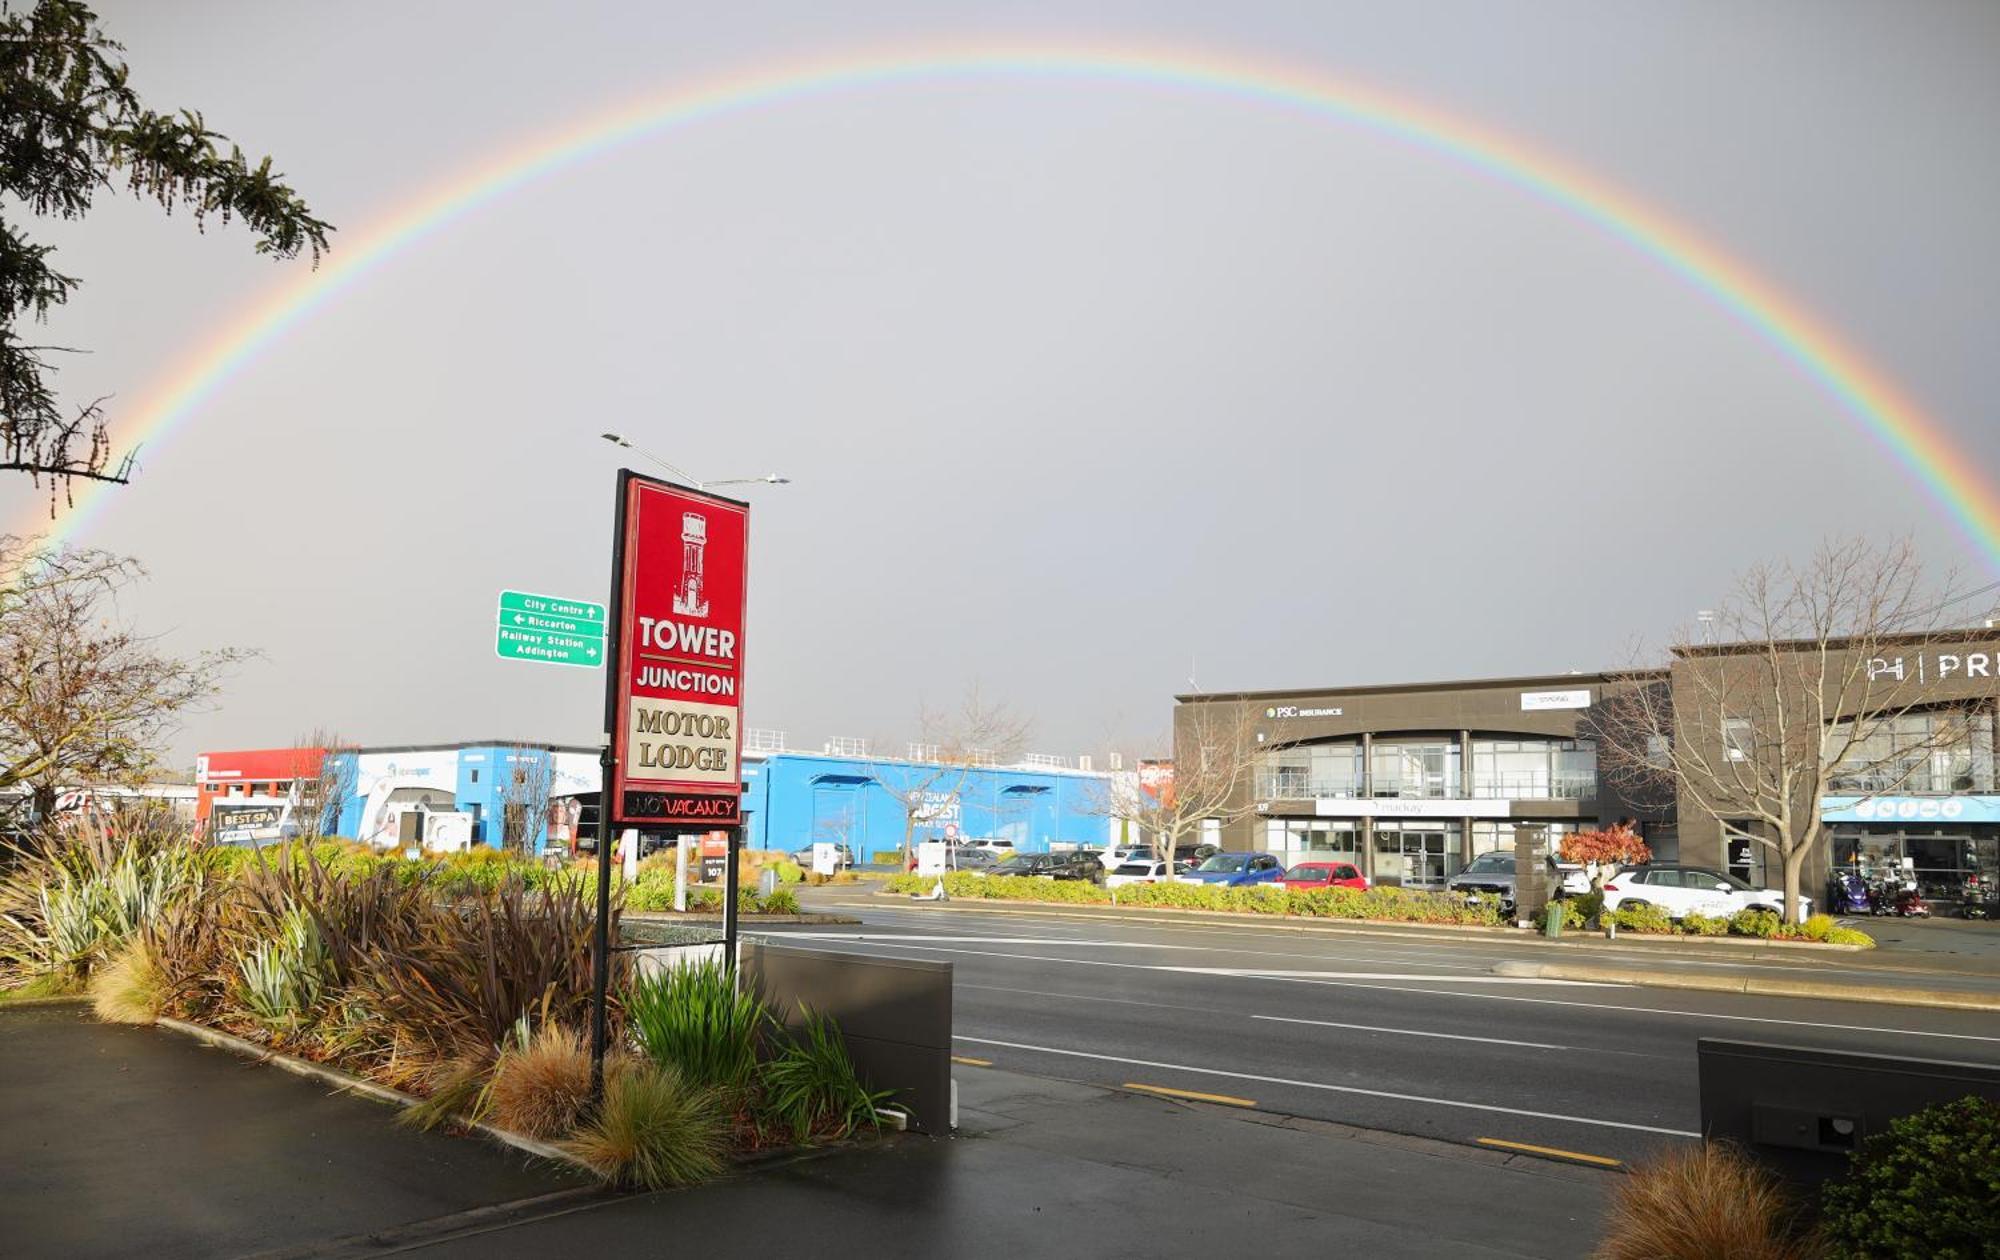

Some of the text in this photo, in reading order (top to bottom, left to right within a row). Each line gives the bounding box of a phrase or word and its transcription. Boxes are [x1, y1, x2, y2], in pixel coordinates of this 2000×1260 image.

[524, 599, 583, 615] City Centre
[528, 616, 576, 631] Riccarton
[501, 630, 584, 648] Railway Station
[639, 616, 736, 659] TOWER
[516, 645, 569, 659] Addington
[1938, 652, 2000, 679] PR
[636, 665, 735, 696] JUNCTION
[1276, 706, 1343, 718] PSC INSURANCE
[636, 708, 731, 739] MOTOR
[638, 742, 728, 771] LODGE
[663, 798, 735, 815] VACANCY
[225, 812, 275, 825] BEST SPA
